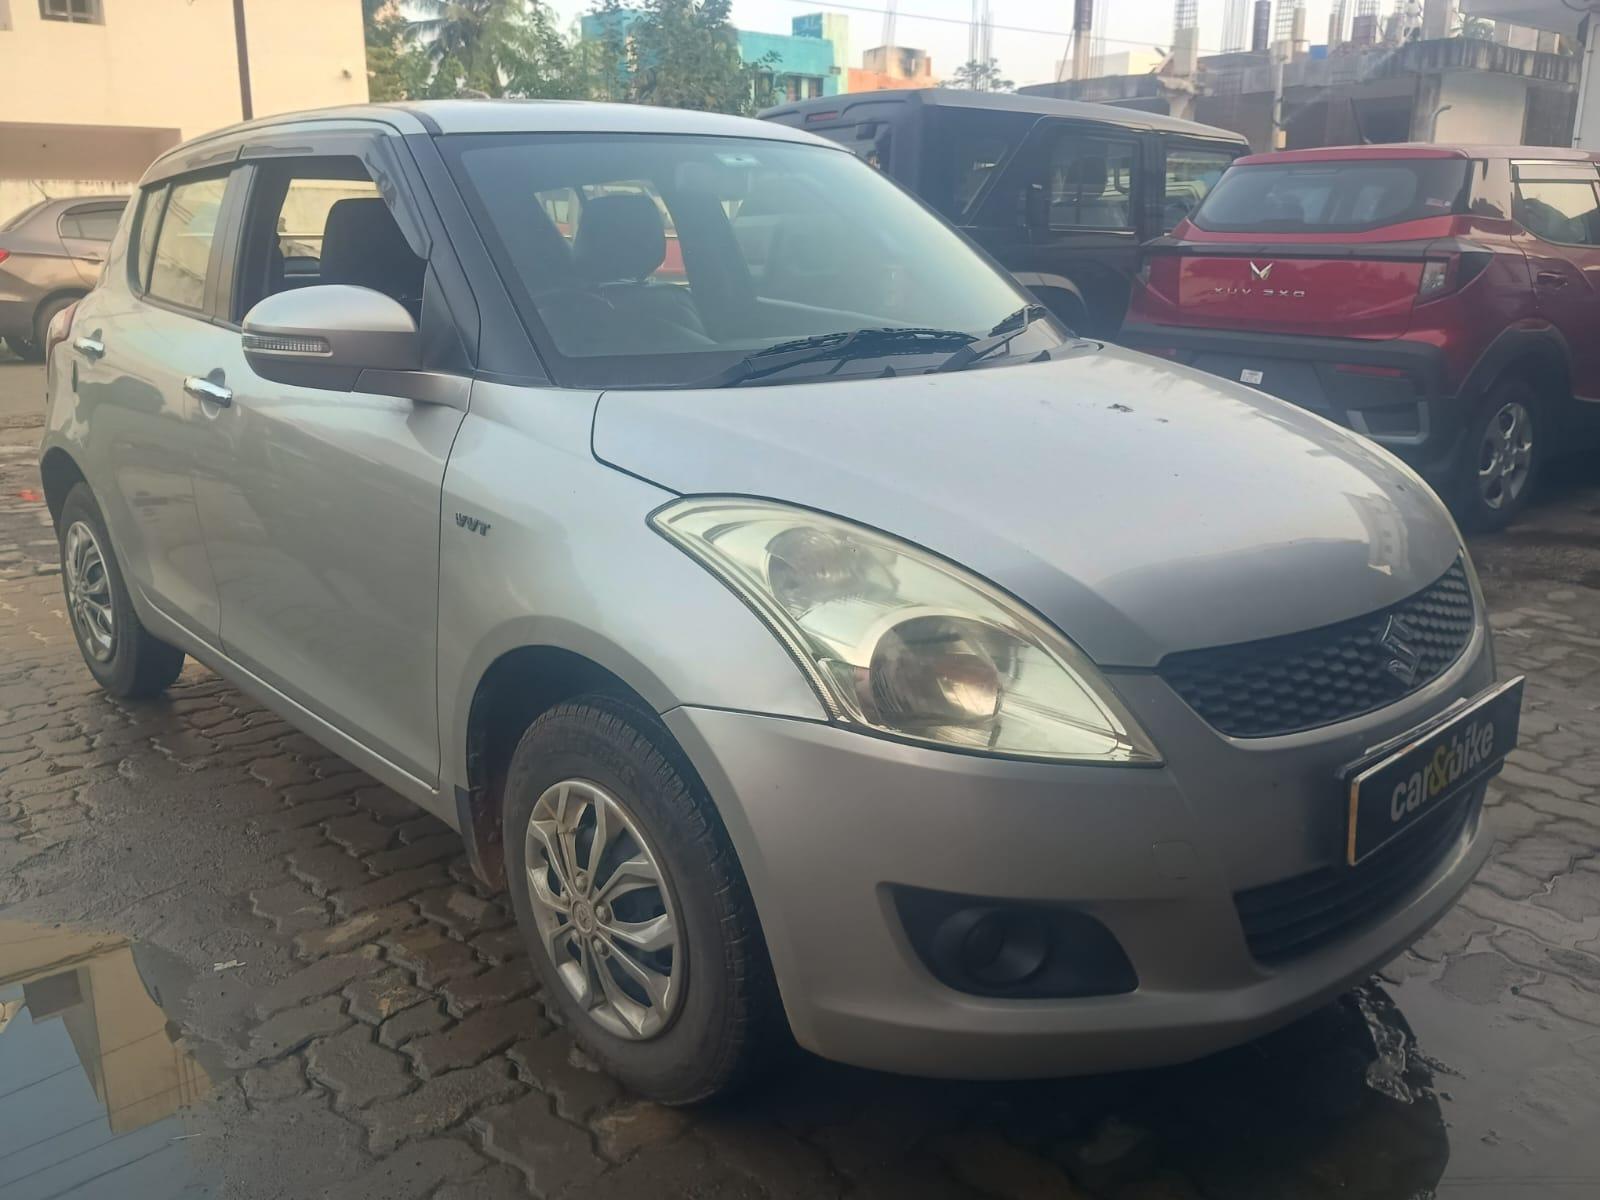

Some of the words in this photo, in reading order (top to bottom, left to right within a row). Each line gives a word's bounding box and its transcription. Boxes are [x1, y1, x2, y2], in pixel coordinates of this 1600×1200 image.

[1214, 286, 1252, 296] XUV
[455, 512, 491, 537] VVT
[1391, 721, 1494, 823] car&bike
